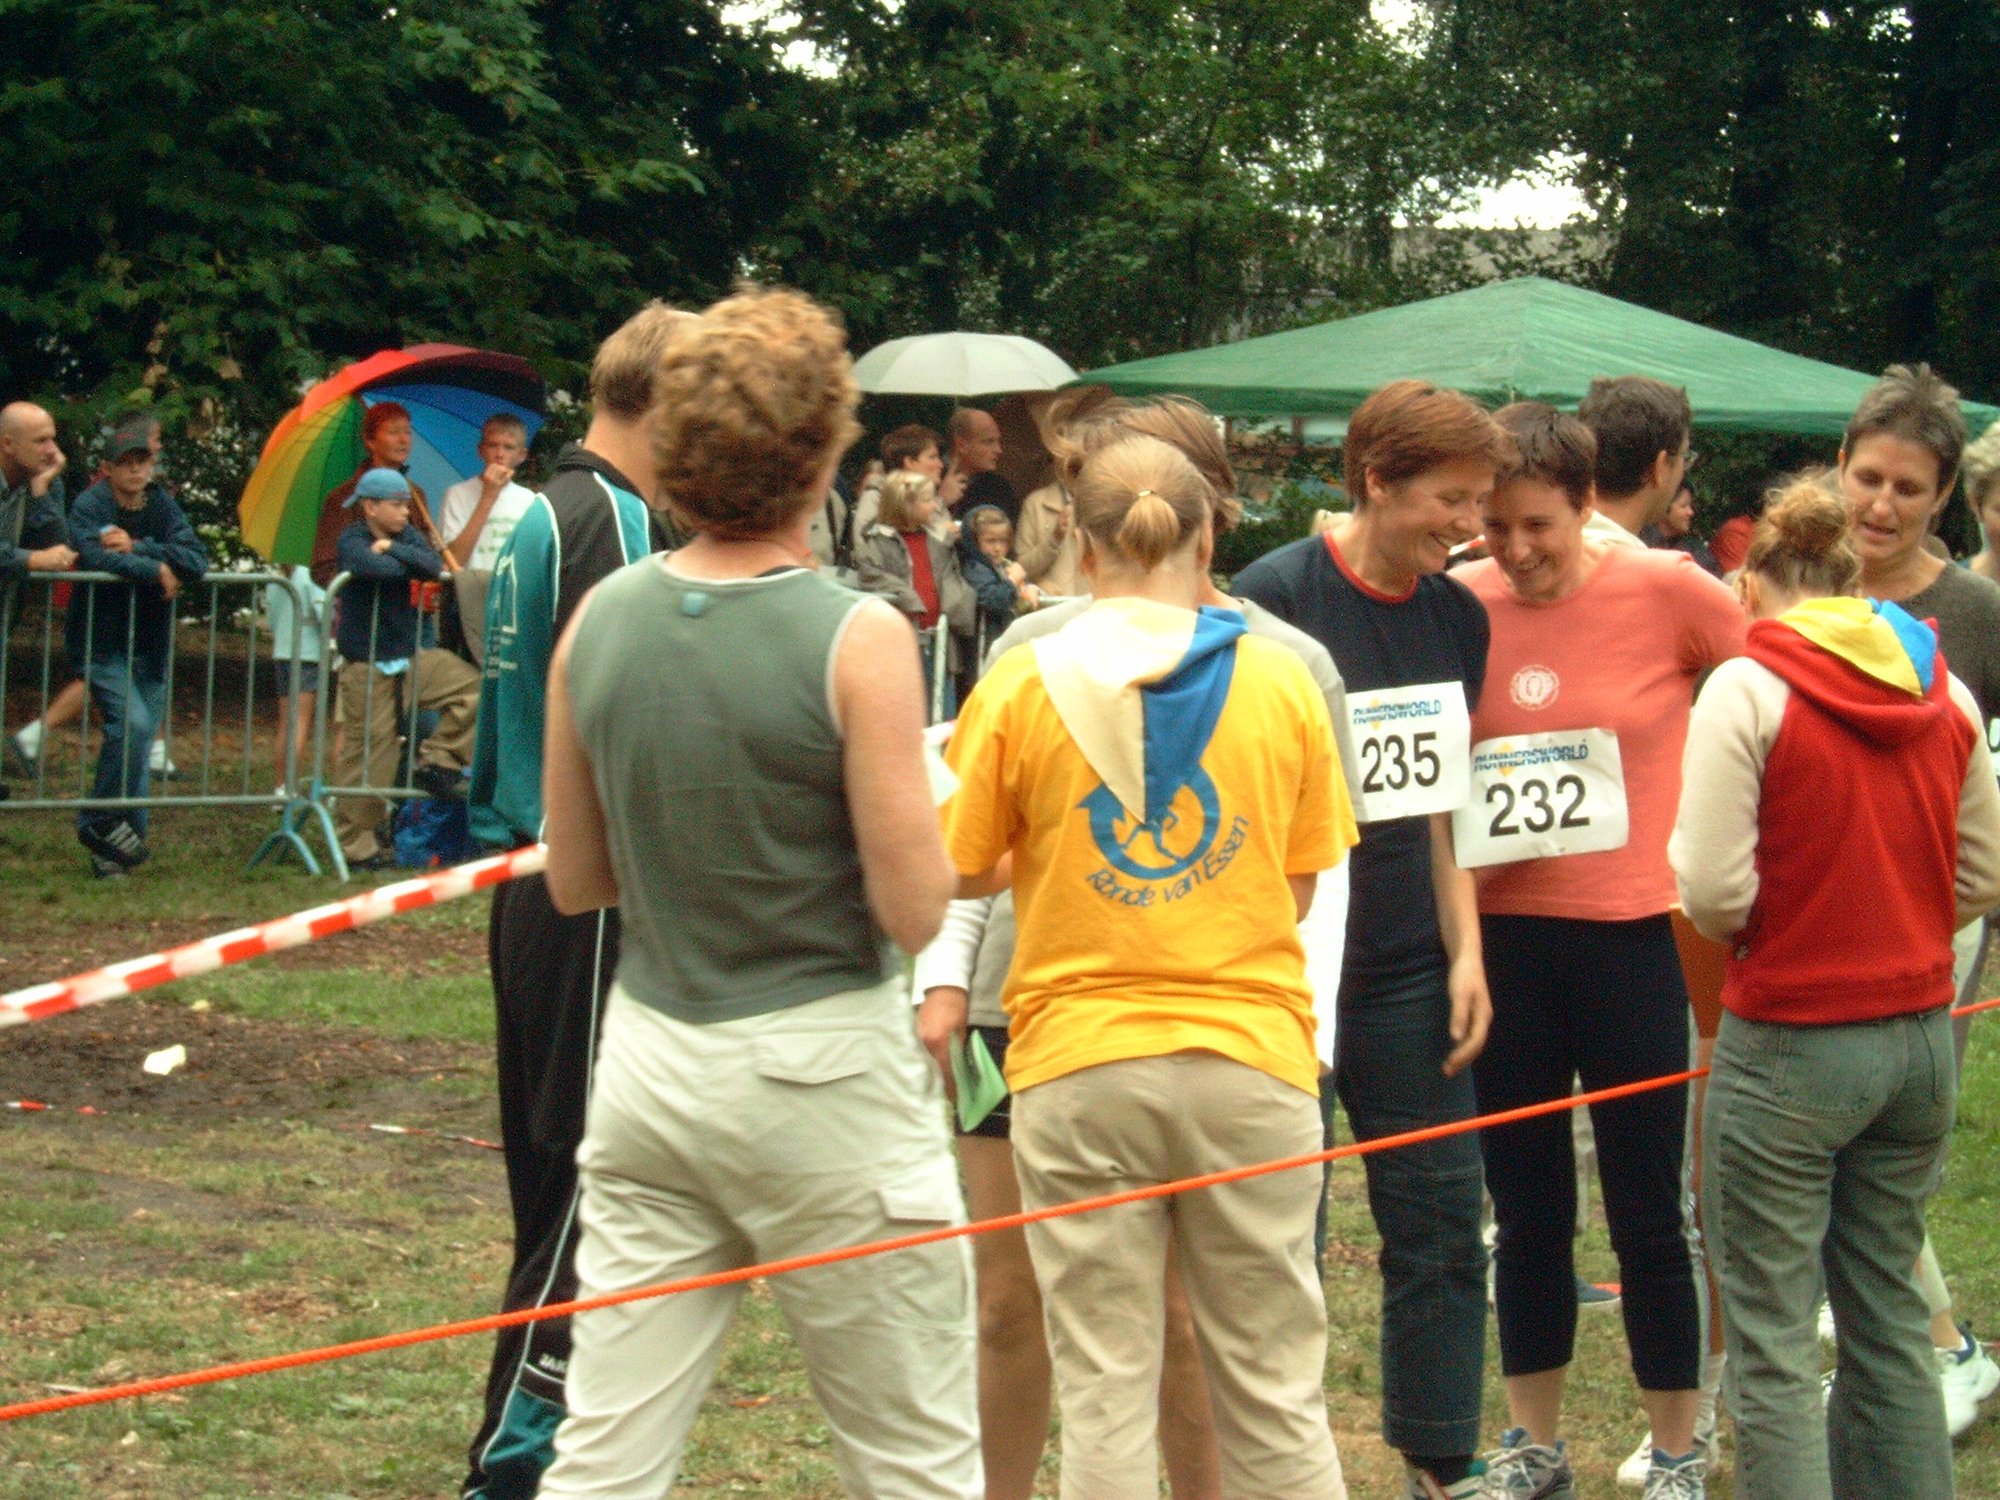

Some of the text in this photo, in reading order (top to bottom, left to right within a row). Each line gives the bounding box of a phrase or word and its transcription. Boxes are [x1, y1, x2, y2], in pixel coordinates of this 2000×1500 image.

[1361, 731, 1441, 793] 235
[1485, 774, 1590, 837] 232
[1163, 869, 1201, 903] van
[1202, 815, 1249, 881] Essen
